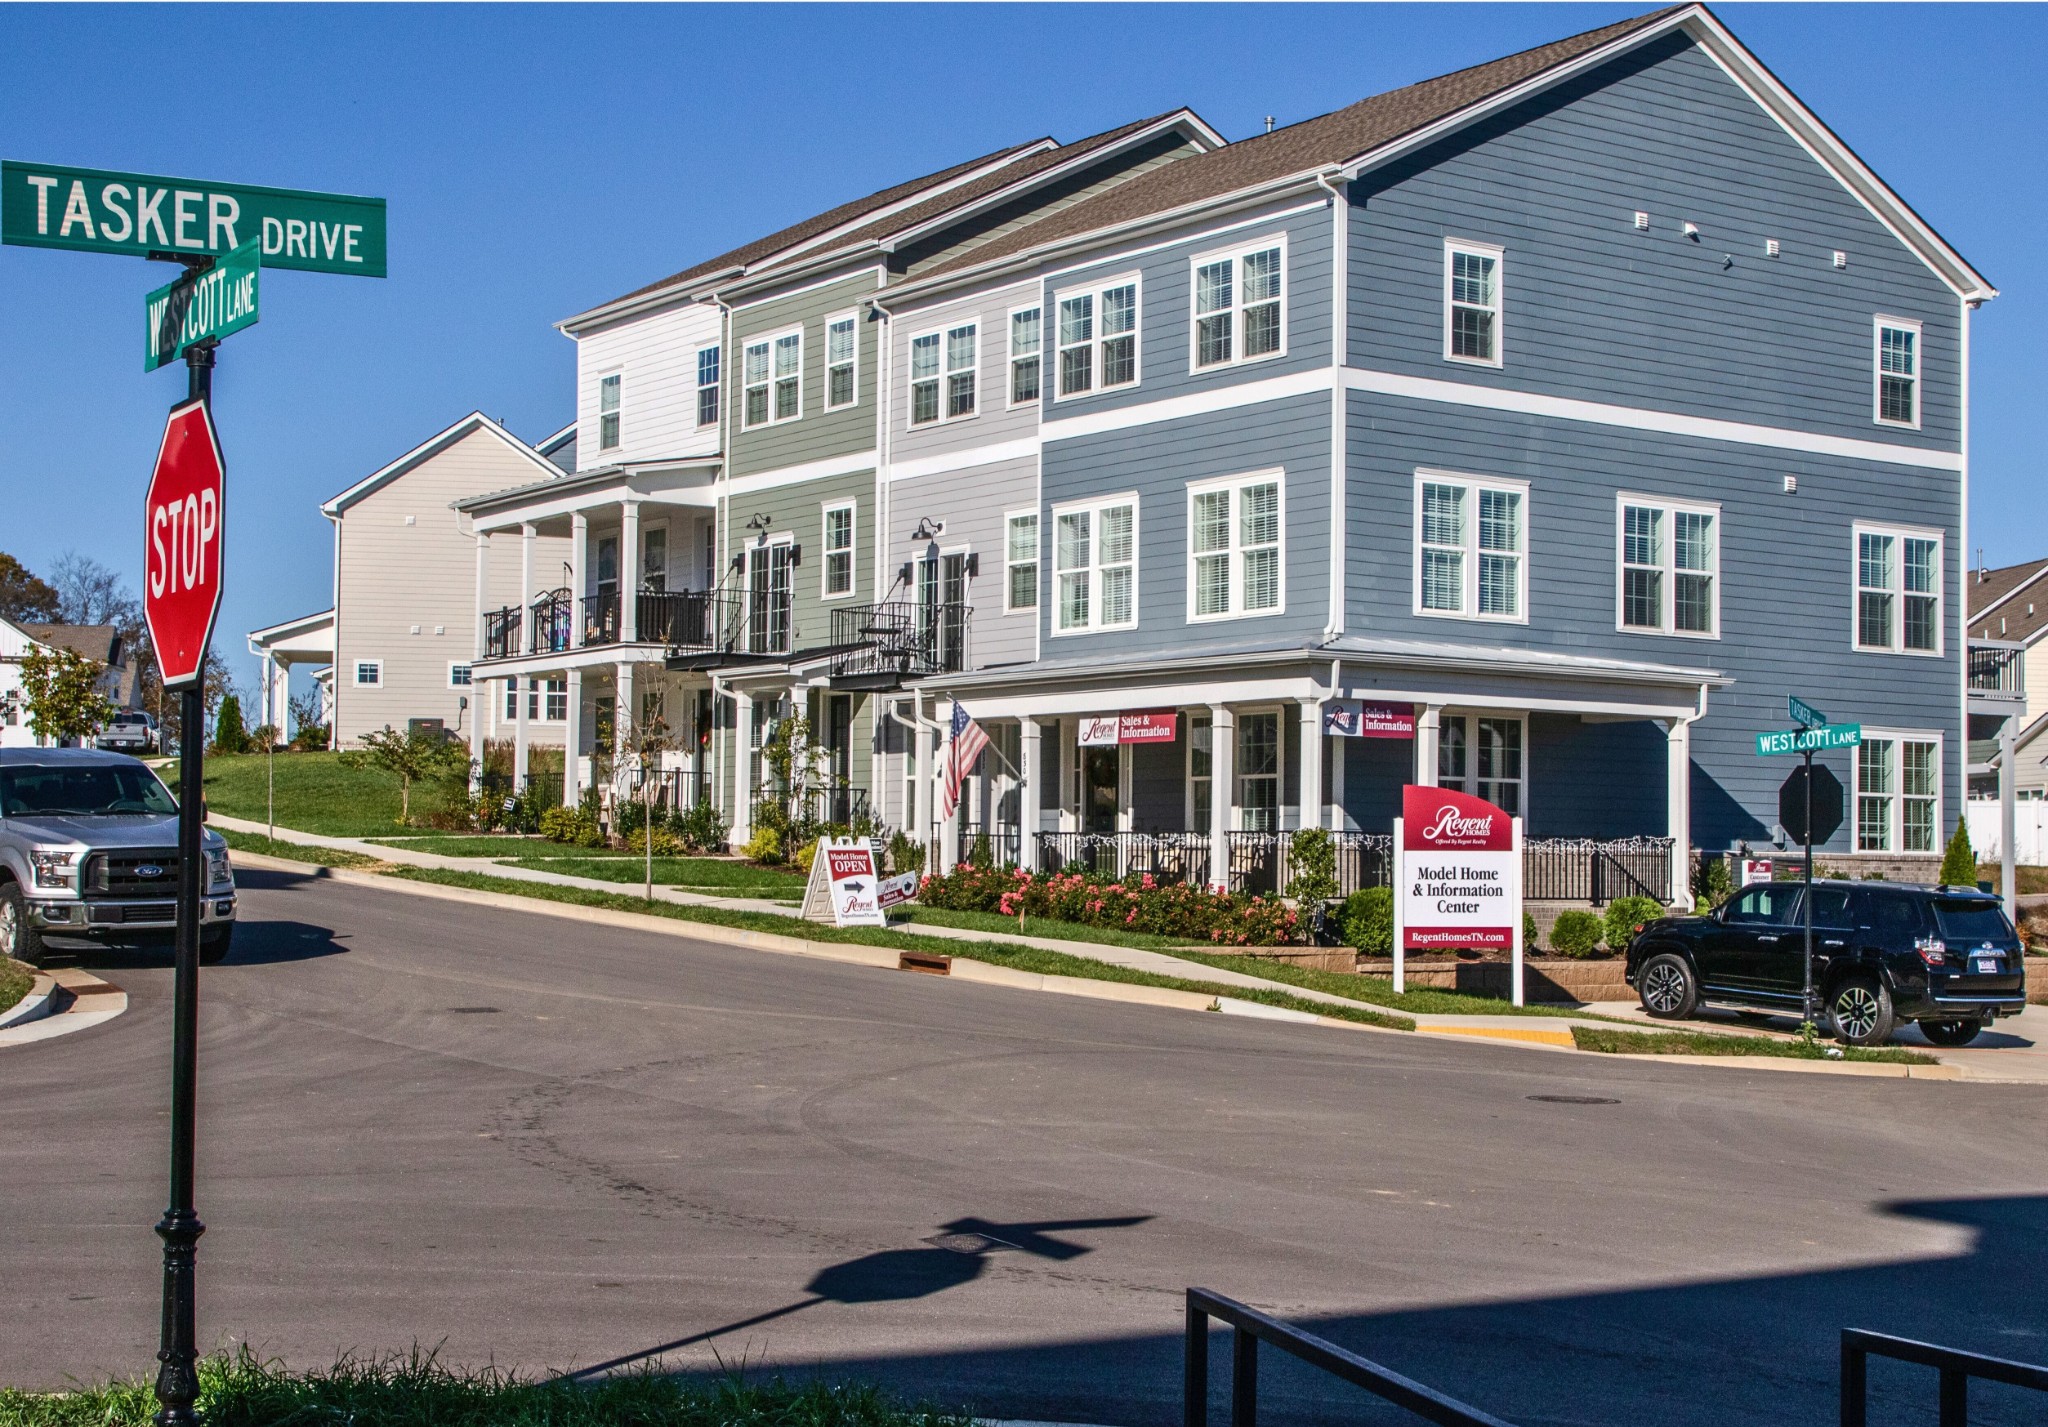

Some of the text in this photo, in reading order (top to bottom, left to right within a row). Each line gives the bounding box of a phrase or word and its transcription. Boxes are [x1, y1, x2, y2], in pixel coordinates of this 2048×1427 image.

[27, 175, 364, 263] TASKER DRIVE
[150, 267, 255, 358] WESTCOTT LANE
[151, 487, 216, 599] STOP
[1365, 707, 1393, 719] Sales &
[1790, 699, 1811, 727] TASKER
[1082, 714, 1116, 741] Regent
[1121, 715, 1150, 726] Sales &
[1365, 719, 1412, 731] Information
[1121, 725, 1170, 738] Information
[1760, 729, 1858, 753] WESTCOTT LANE
[1423, 805, 1493, 839] Regent
[835, 860, 867, 872] OPEN
[1418, 866, 1499, 880] Model Home
[1412, 883, 1503, 897] & Information
[842, 895, 873, 913] Regent
[1437, 900, 1480, 913] Center
[1412, 932, 1505, 943] RegentHomesTN.com
